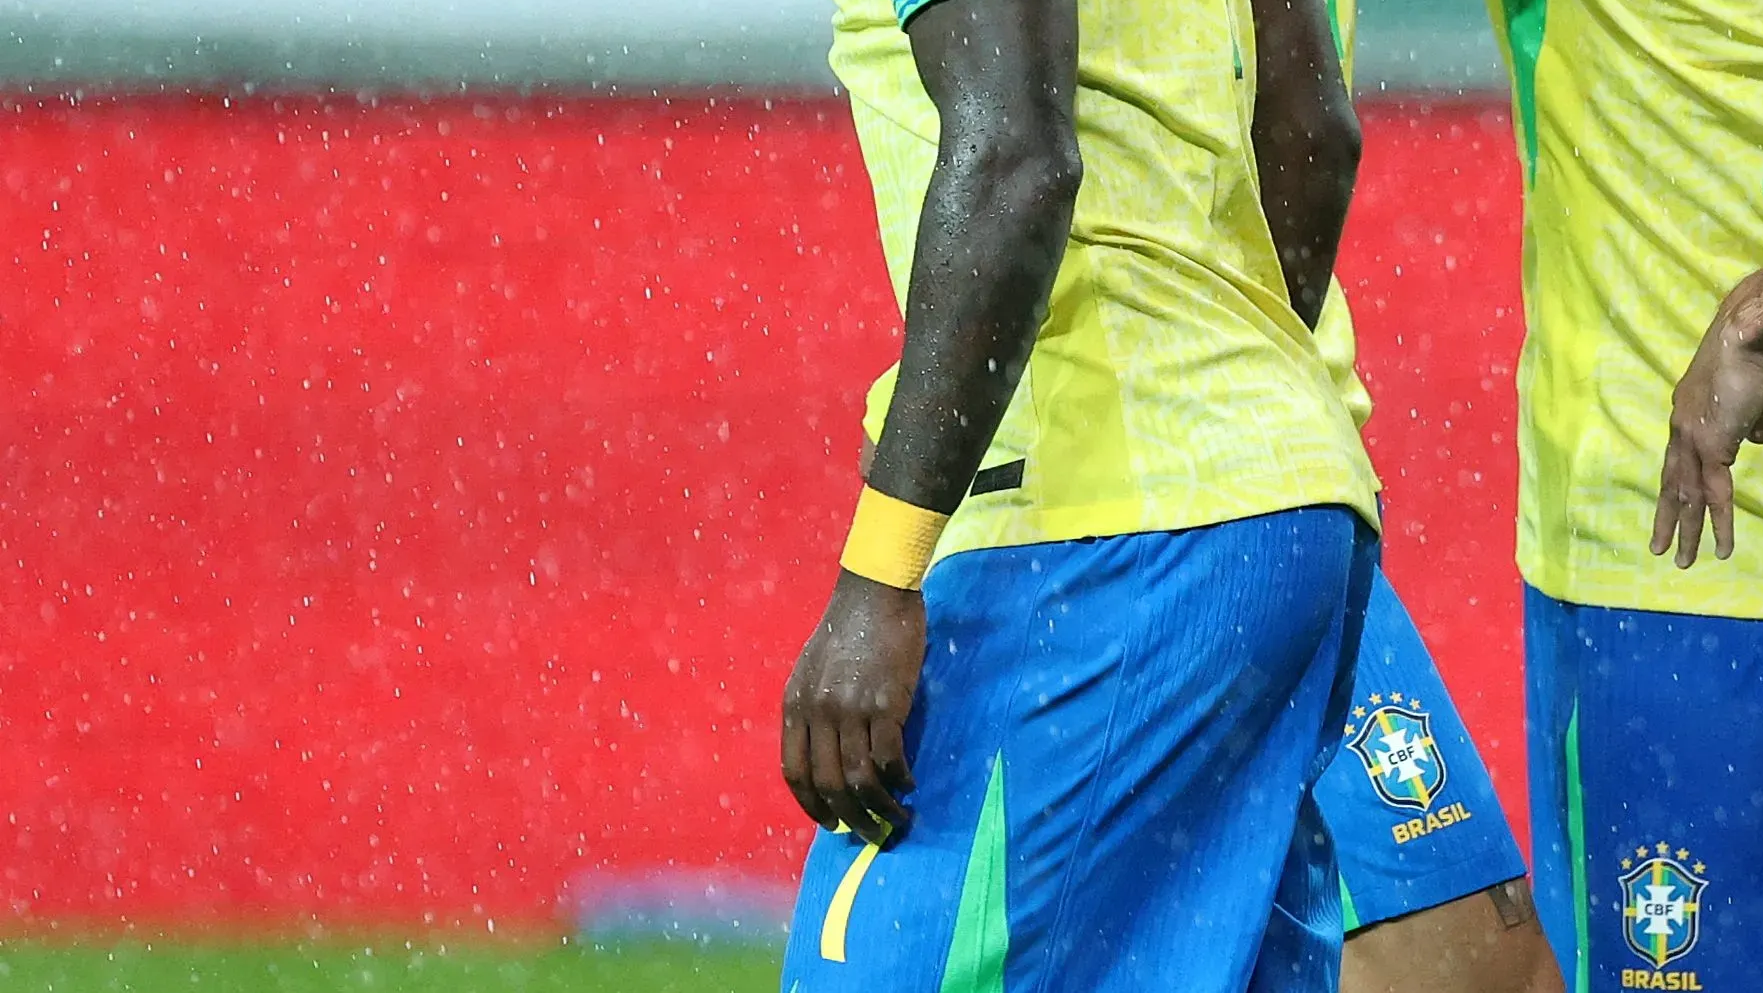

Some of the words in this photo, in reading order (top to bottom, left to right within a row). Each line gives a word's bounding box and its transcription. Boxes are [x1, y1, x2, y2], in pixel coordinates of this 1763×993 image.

[1388, 745, 1415, 766] CBF
[1391, 801, 1472, 844] BRASIL
[1644, 903, 1674, 916] CBF
[1621, 968, 1703, 991] BRASIL
